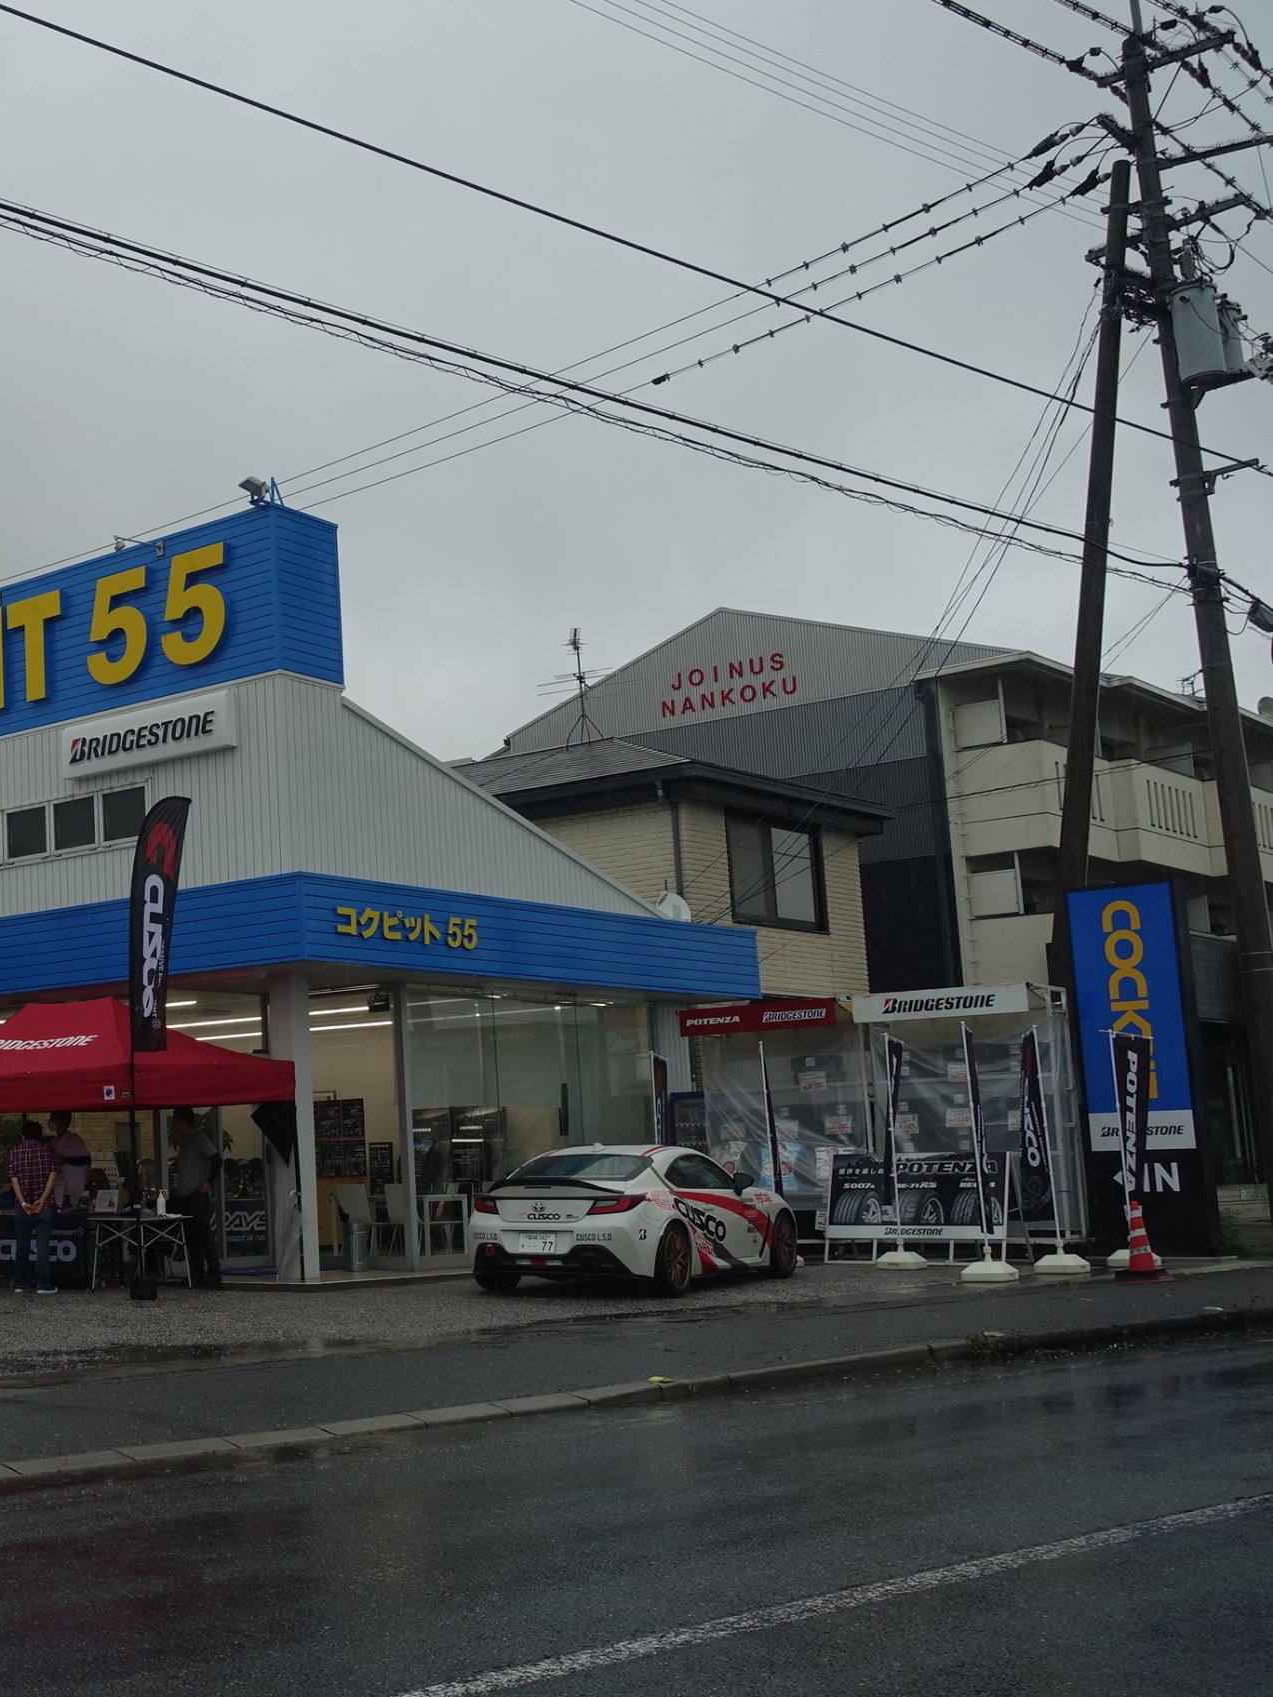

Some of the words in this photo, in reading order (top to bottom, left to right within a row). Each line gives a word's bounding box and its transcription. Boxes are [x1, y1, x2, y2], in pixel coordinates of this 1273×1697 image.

[87, 541, 227, 686] 55
[671, 652, 785, 691] JOINUS
[661, 675, 797, 718] NANKOKU
[69, 710, 215, 765] BRIDGESTONE
[142, 873, 165, 1018] CUSCO
[336, 906, 441, 945] コクピット
[447, 916, 478, 950] 55
[686, 1015, 741, 1027] POTENZA
[763, 1009, 827, 1022] BRIDGESTONE
[882, 994, 996, 1014] BRIDGESTONE
[1100, 1125, 1185, 1138] BRSTONE
[1124, 1049, 1139, 1193] POTENZA
[1143, 1161, 1181, 1193] IN
[576, 1233, 596, 1242] CUSCO
[674, 1197, 727, 1242] CUSCO
[884, 1227, 945, 1236] BRDGESTONE
